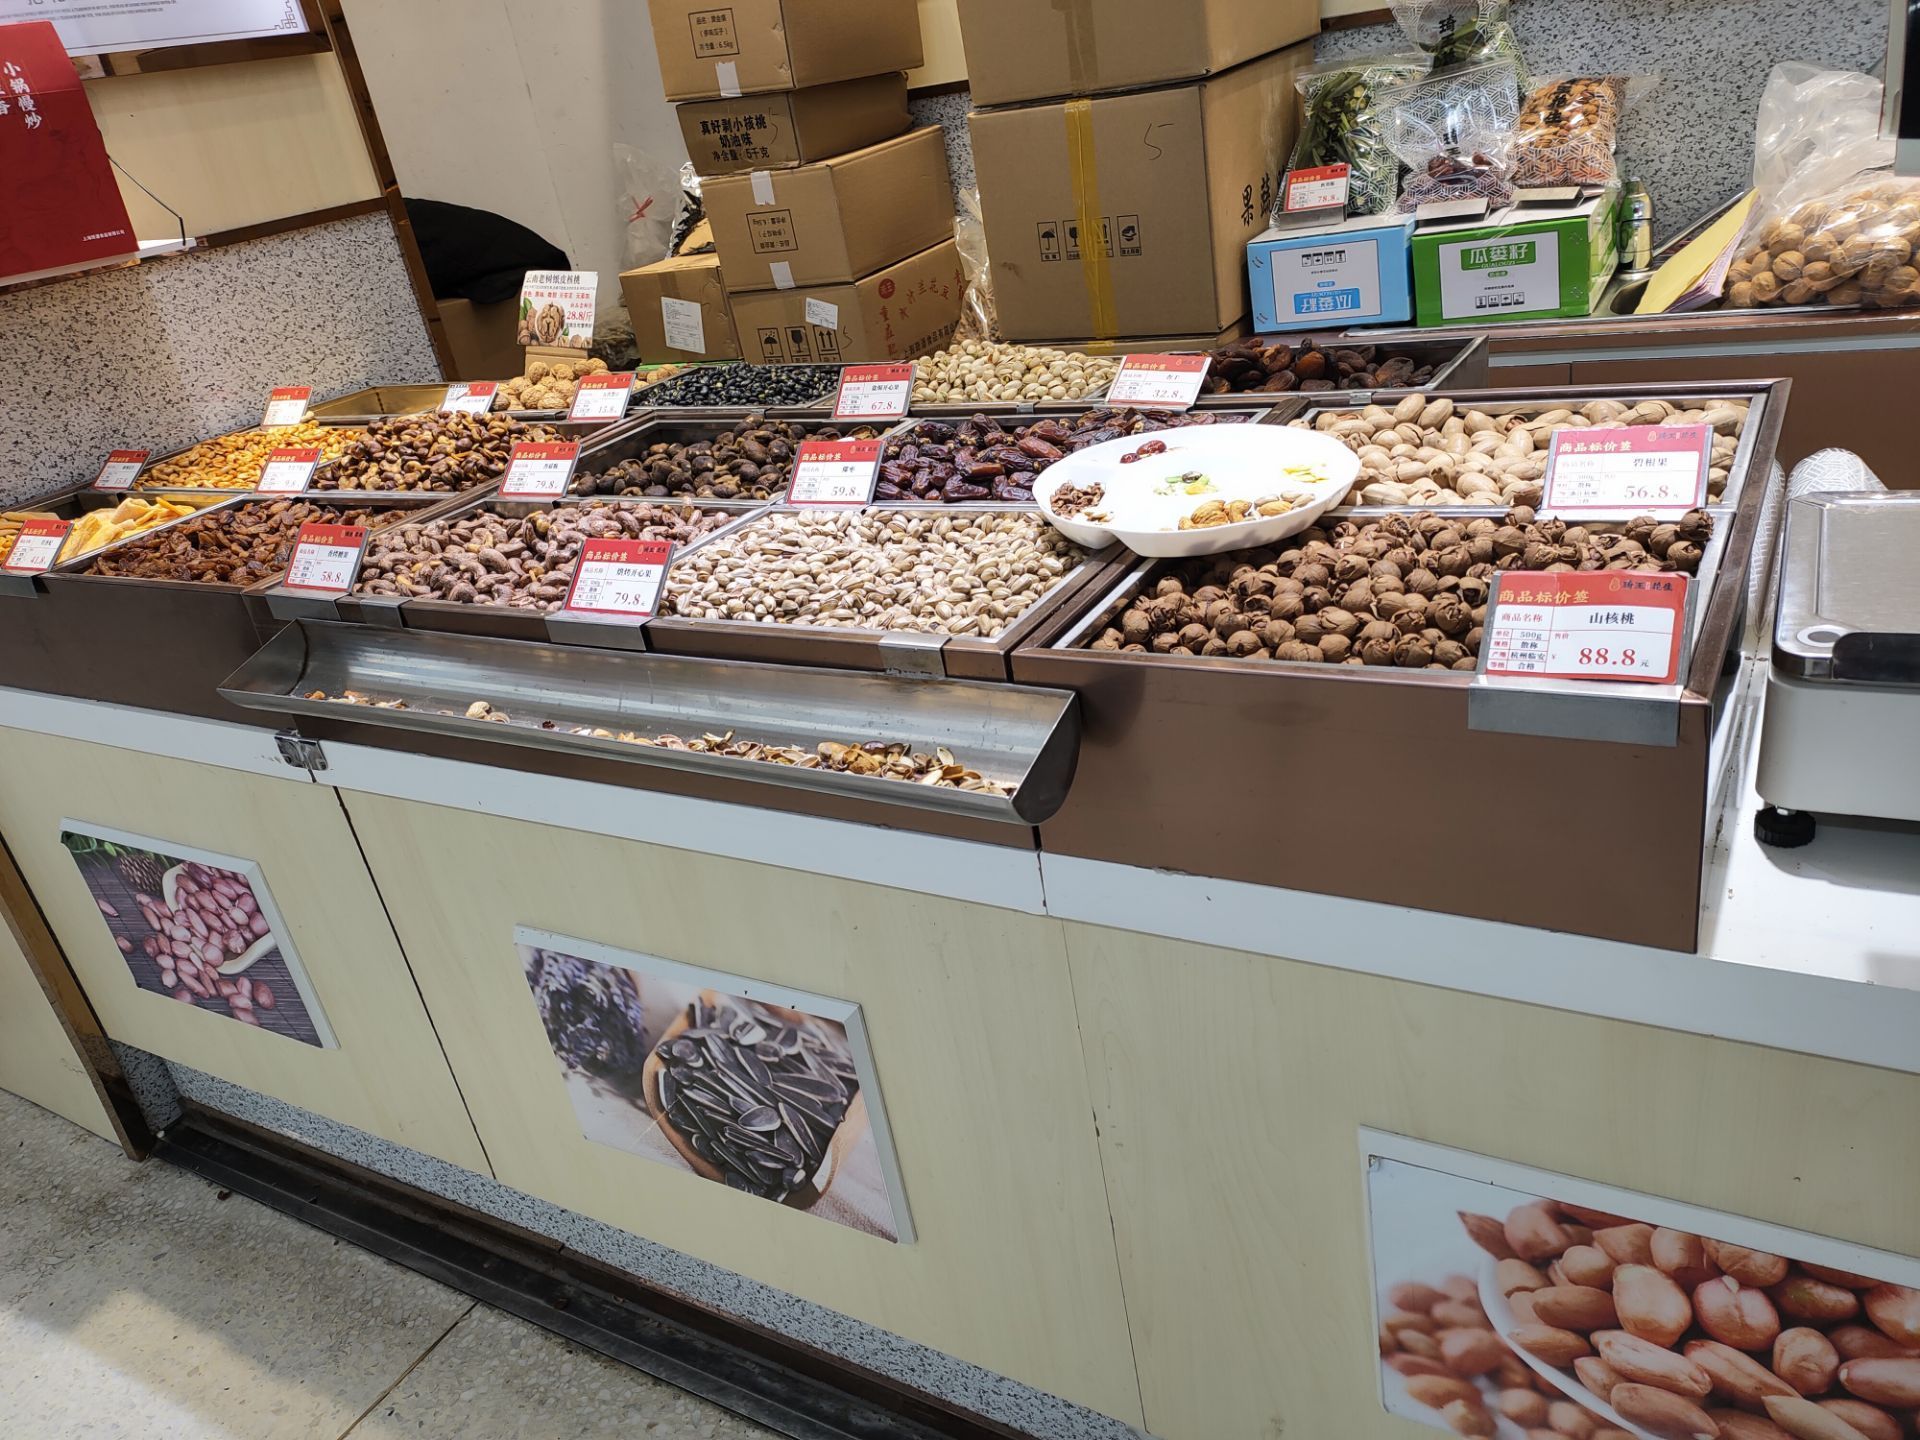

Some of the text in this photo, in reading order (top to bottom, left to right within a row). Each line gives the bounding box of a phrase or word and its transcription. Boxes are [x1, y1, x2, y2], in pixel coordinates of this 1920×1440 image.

[4, 62, 42, 129] 小锅慢炒
[720, 132, 753, 148] 奶油味
[1144, 123, 1175, 161] 5
[871, 401, 893, 411] 67.8
[1559, 441, 1632, 453] 商品标价签
[535, 480, 555, 488] 79.8
[831, 486, 857, 496] 59.8
[1625, 485, 1669, 499] 56.8
[585, 550, 628, 561] 商品标价签
[321, 570, 342, 583] 58.8
[613, 592, 641, 606] 79.8
[1499, 590, 1590, 604] 商品标价签
[1501, 612, 1636, 625] 商品名称 山核桃
[1520, 631, 1542, 640] 500g
[1578, 647, 1636, 666] 88.8
[1517, 662, 1536, 670] 合格
